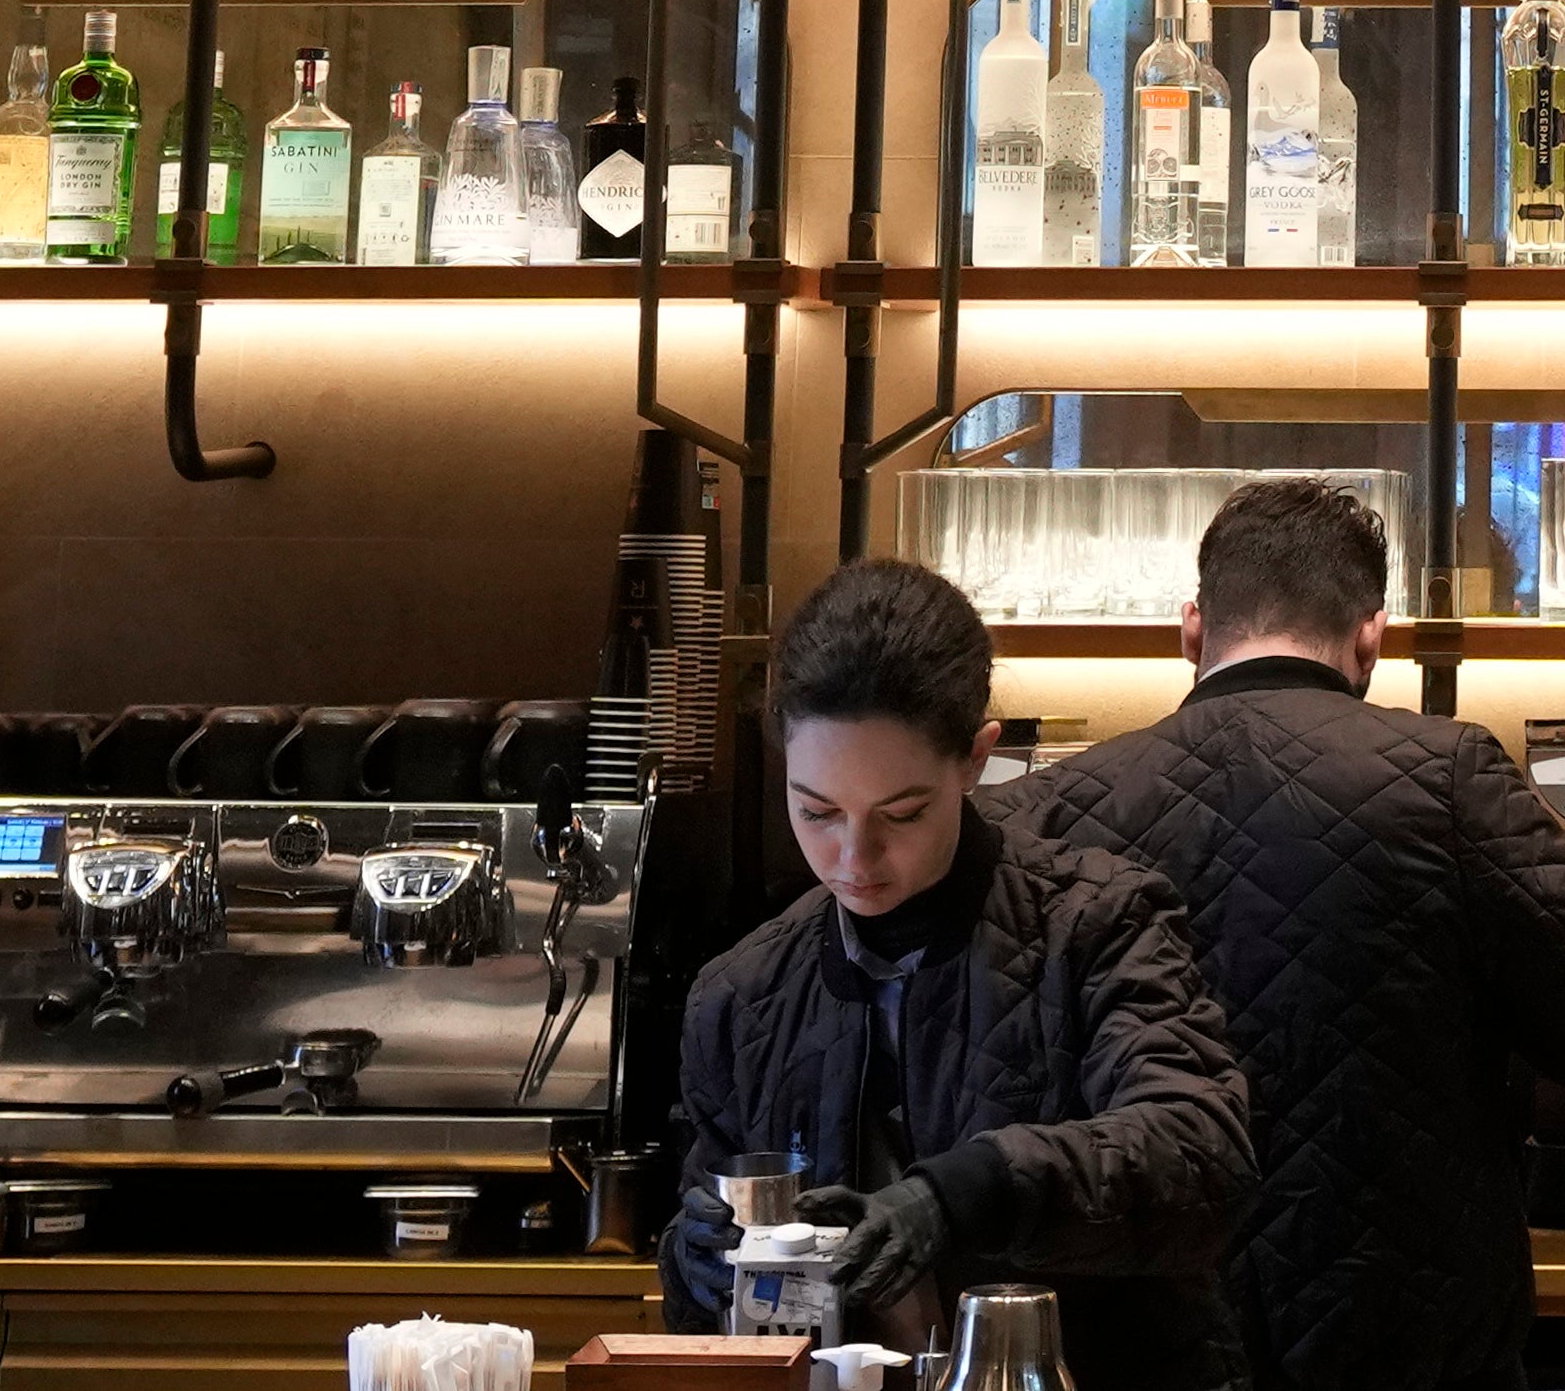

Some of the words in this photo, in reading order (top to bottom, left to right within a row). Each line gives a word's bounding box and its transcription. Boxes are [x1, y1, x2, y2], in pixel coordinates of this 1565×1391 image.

[271, 145, 338, 158] SABATINI
[283, 162, 319, 174] GIN
[978, 169, 1038, 186] BELVEDERE
[582, 186, 644, 198] HENDRIC
[456, 214, 506, 226] MARE
